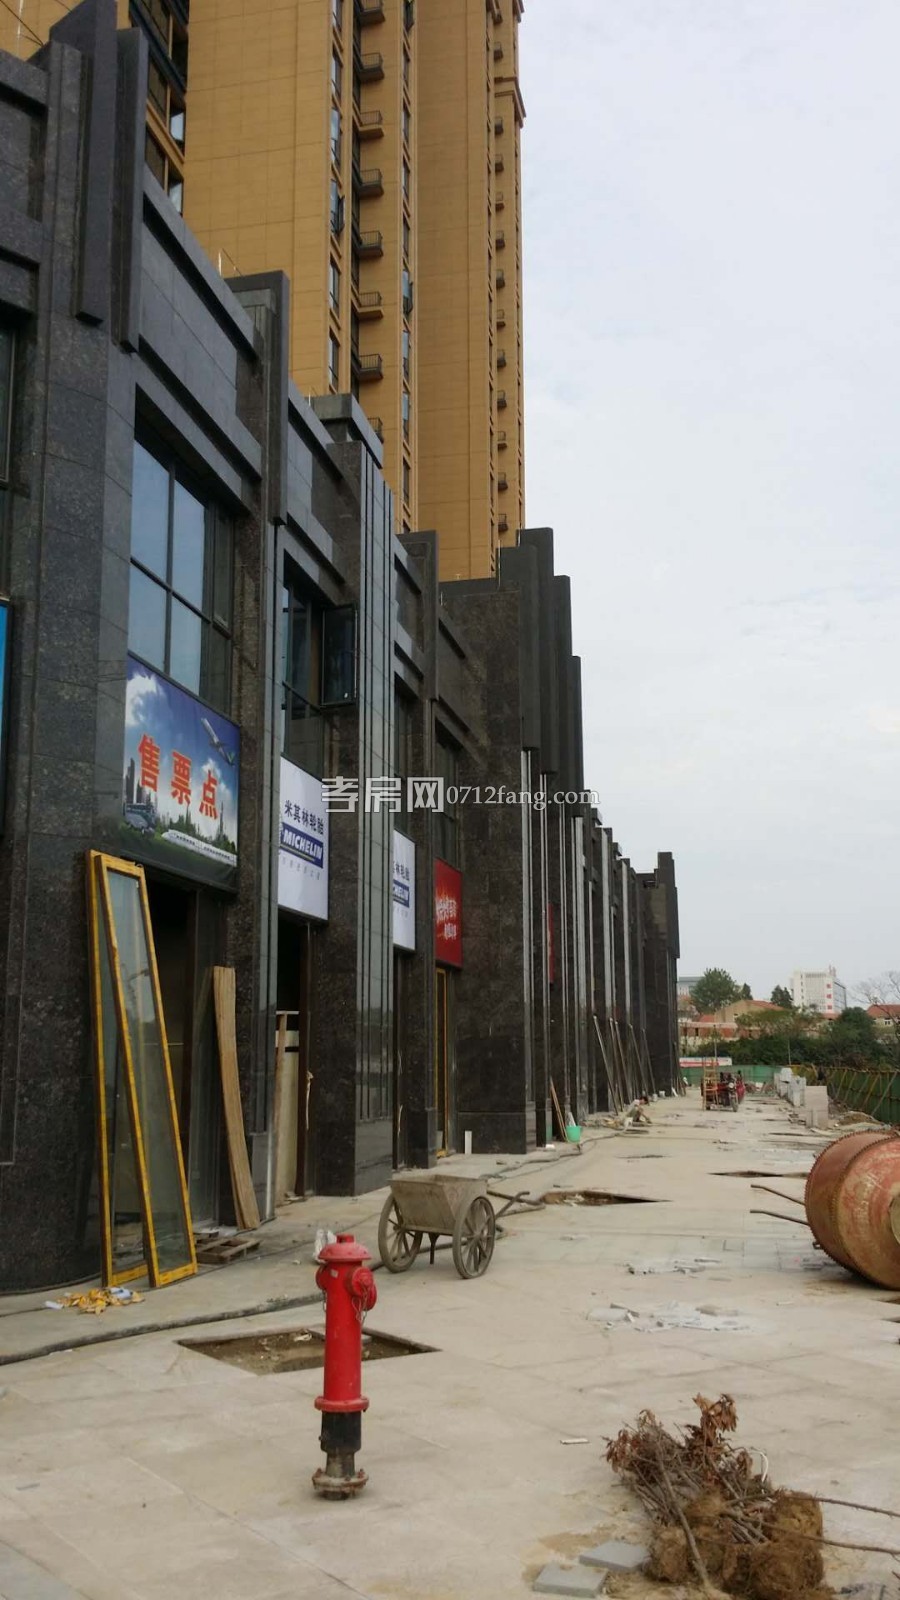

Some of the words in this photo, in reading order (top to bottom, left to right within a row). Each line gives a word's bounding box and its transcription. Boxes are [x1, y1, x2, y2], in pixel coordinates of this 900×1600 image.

[138, 733, 218, 820] 售票点
[284, 799, 324, 835] 米其林轮胎
[283, 828, 323, 860] MICHELIN
